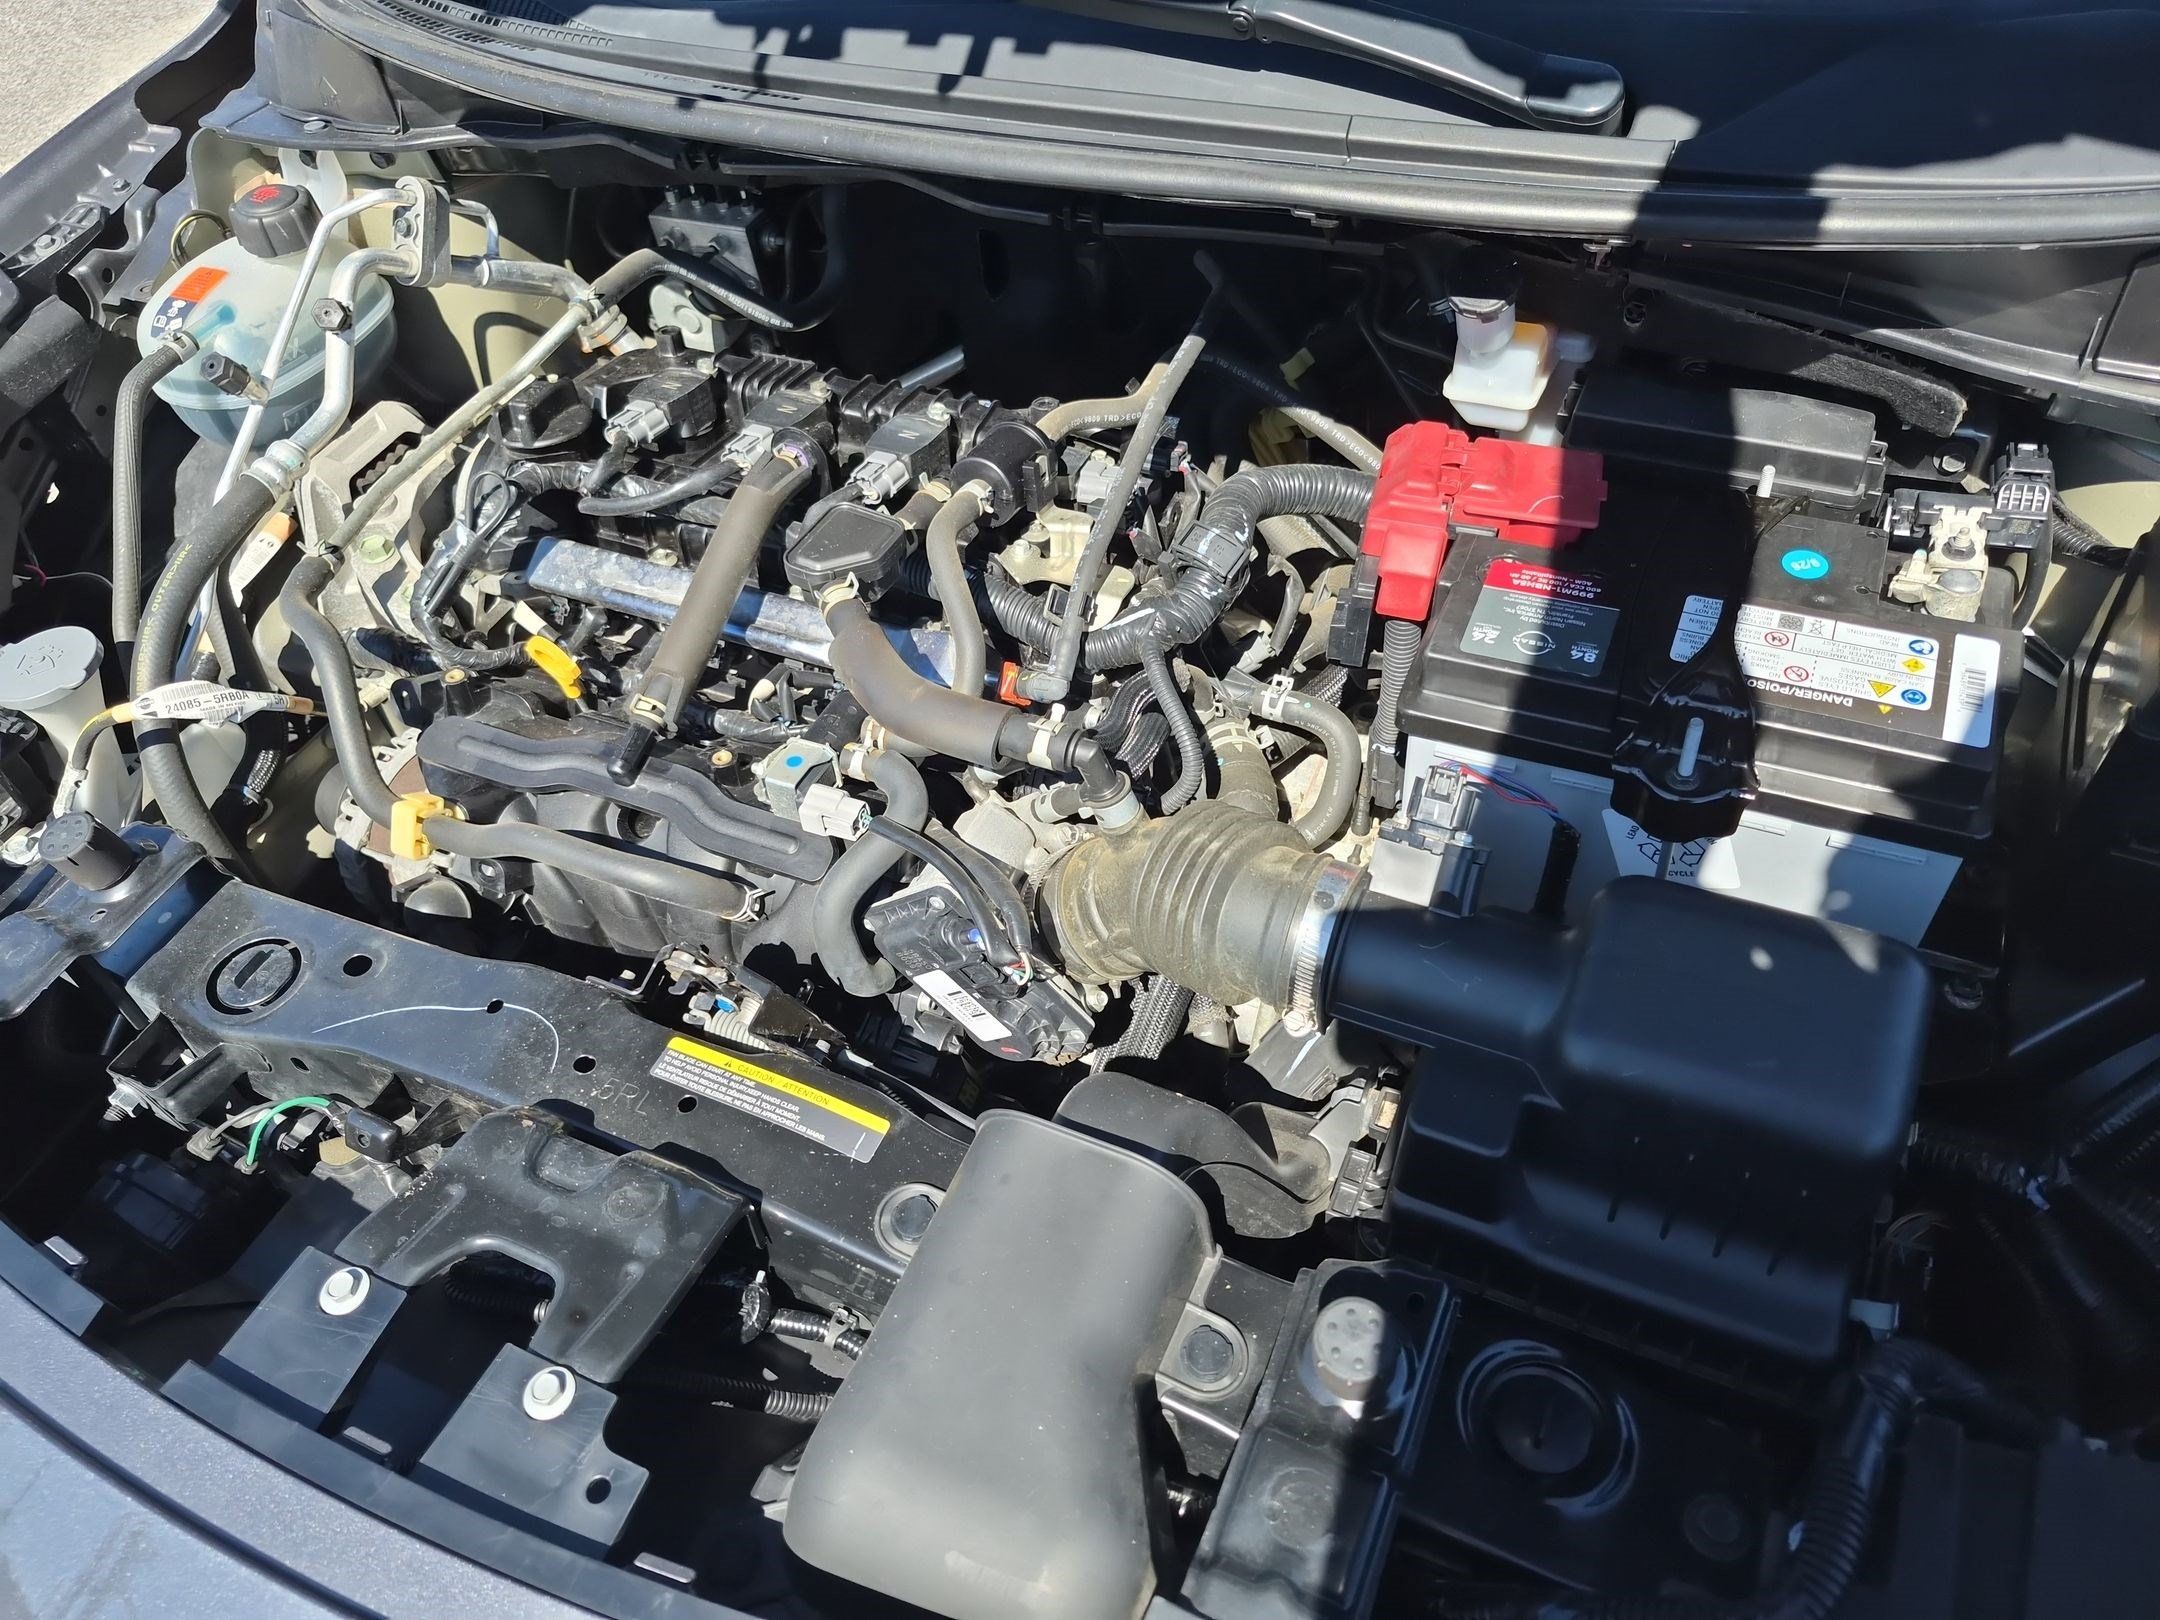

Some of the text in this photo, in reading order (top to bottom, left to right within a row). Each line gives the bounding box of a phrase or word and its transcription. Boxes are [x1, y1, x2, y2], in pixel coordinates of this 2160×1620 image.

[1564, 618, 1585, 626] Nissan
[1471, 630, 1497, 643] 24
[1512, 636, 1555, 648] NISSAN
[1570, 649, 1596, 662] 84
[1820, 675, 1864, 688] EXPLOSIVE
[1837, 672, 1865, 682] GASES
[1747, 679, 1852, 706] DANGER/POISO
[1626, 825, 1640, 840] LEAD
[666, 1049, 679, 1057] FAN
[677, 1053, 696, 1064] BLADE
[695, 1060, 708, 1068] CAN
[707, 1065, 724, 1074] START
[665, 1065, 699, 1081] VENTILATEUR
[698, 1077, 719, 1089] RISQUE
[726, 1088, 756, 1103] DÉMARRER
[760, 1101, 776, 1111] TOUT
[670, 1058, 686, 1067] HELP
[684, 1064, 701, 1073] AVOID
[701, 1070, 728, 1084] PERSONAL
[760, 1093, 781, 1104] HANDS
[737, 1064, 774, 1082] CAUTION
[782, 1082, 829, 1104] ATTENTION
[653, 1068, 670, 1078] POUR
[687, 1081, 705, 1092] TOUTE
[741, 1102, 753, 1110] PAS
[760, 1110, 795, 1127] APPROCHER
[794, 1123, 806, 1132] LES
